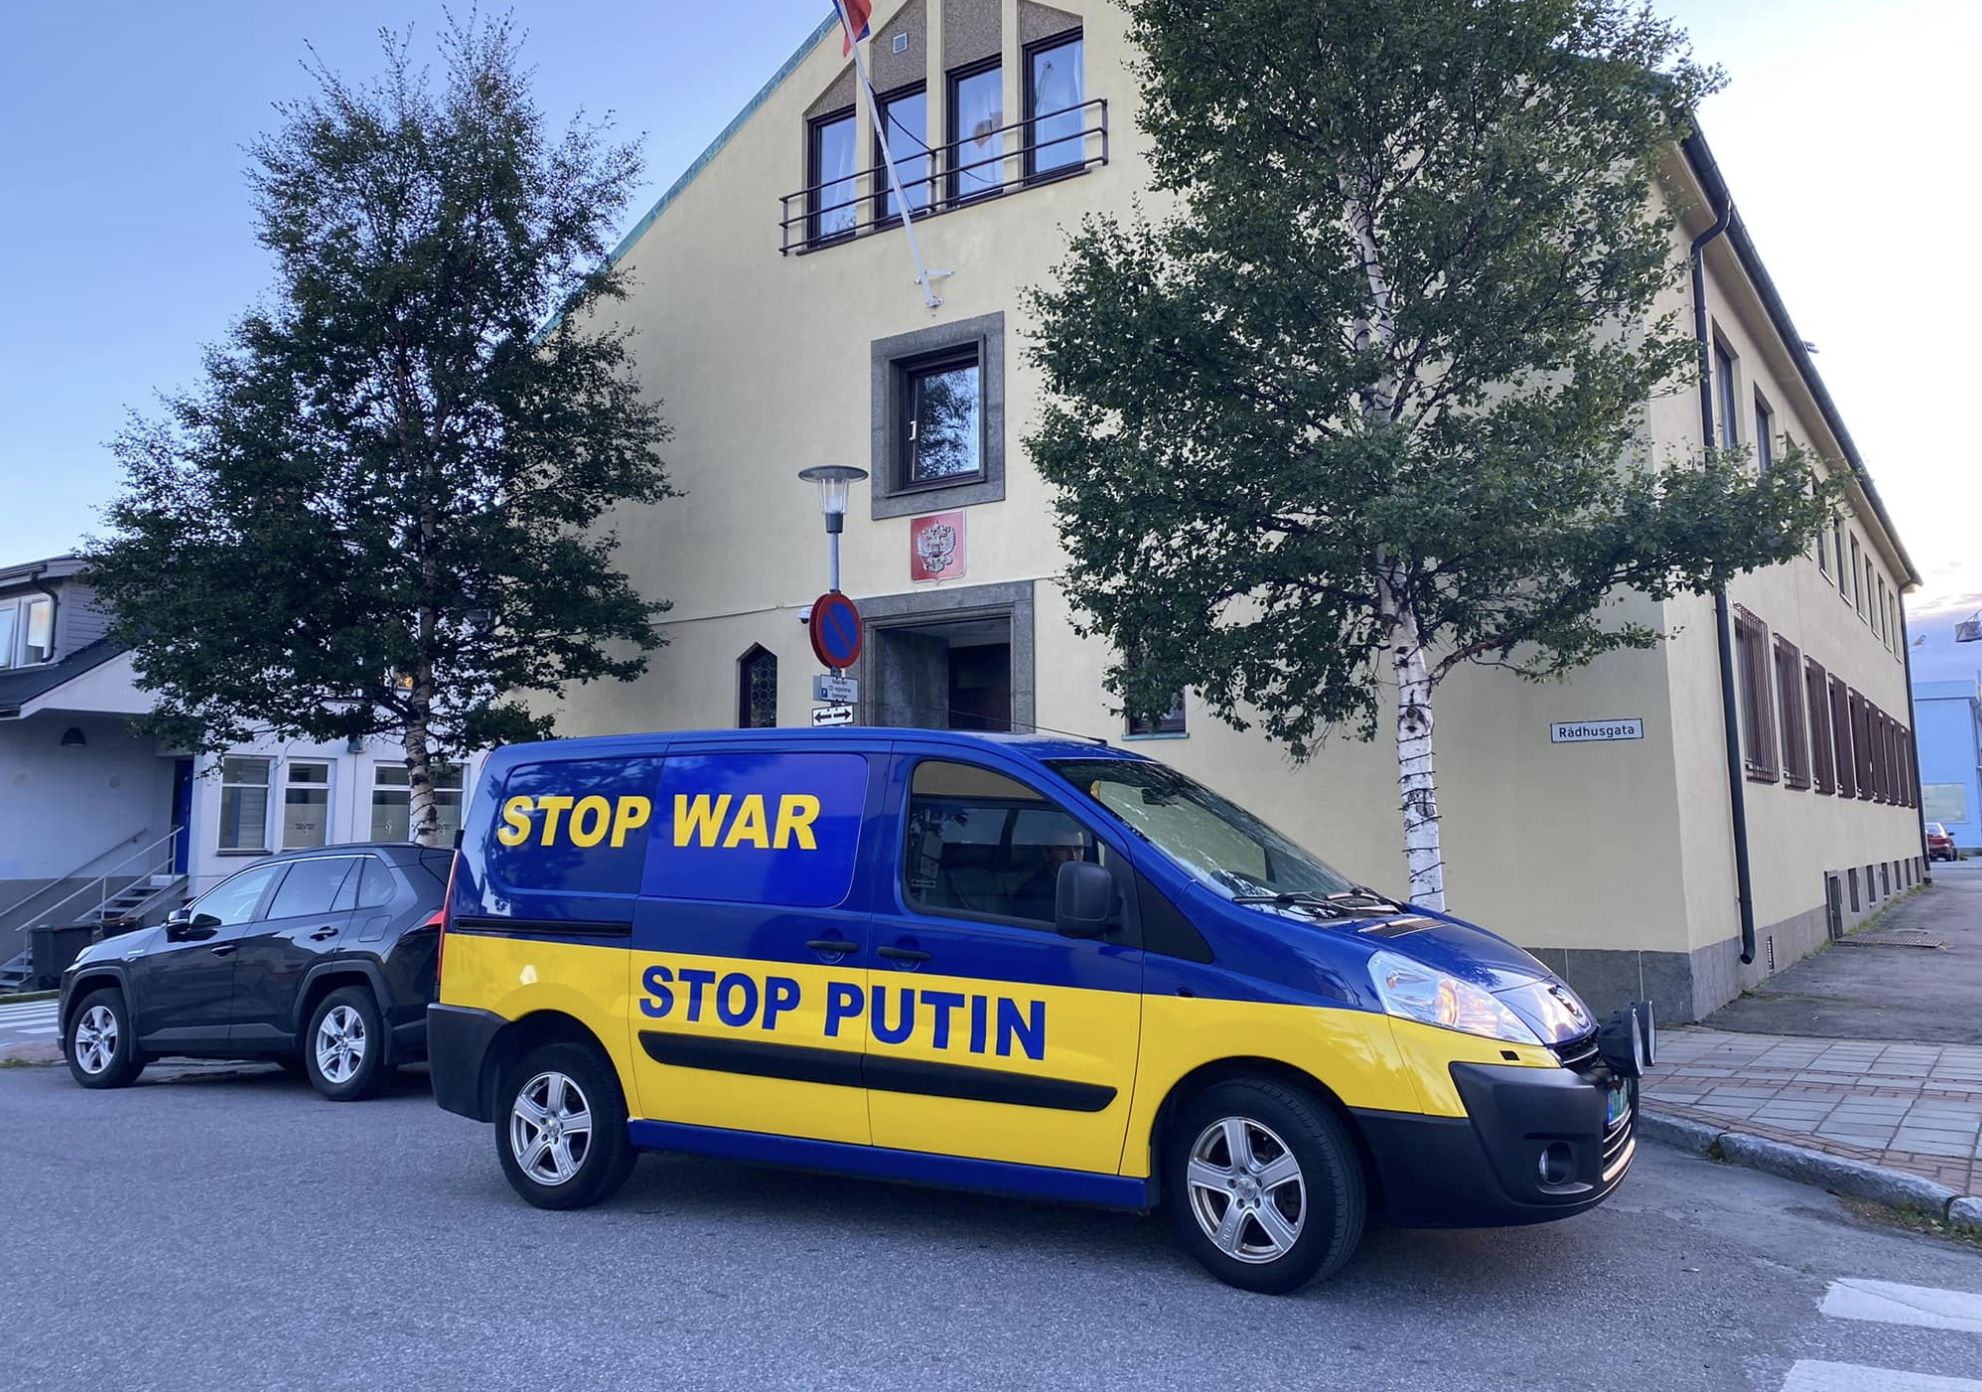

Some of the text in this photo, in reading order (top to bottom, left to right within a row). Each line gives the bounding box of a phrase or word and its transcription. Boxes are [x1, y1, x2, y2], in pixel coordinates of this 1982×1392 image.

[1559, 725, 1635, 739] Rådhusgata
[497, 793, 821, 850] STOP WAR
[639, 965, 1046, 1060] STOP PUTIN
